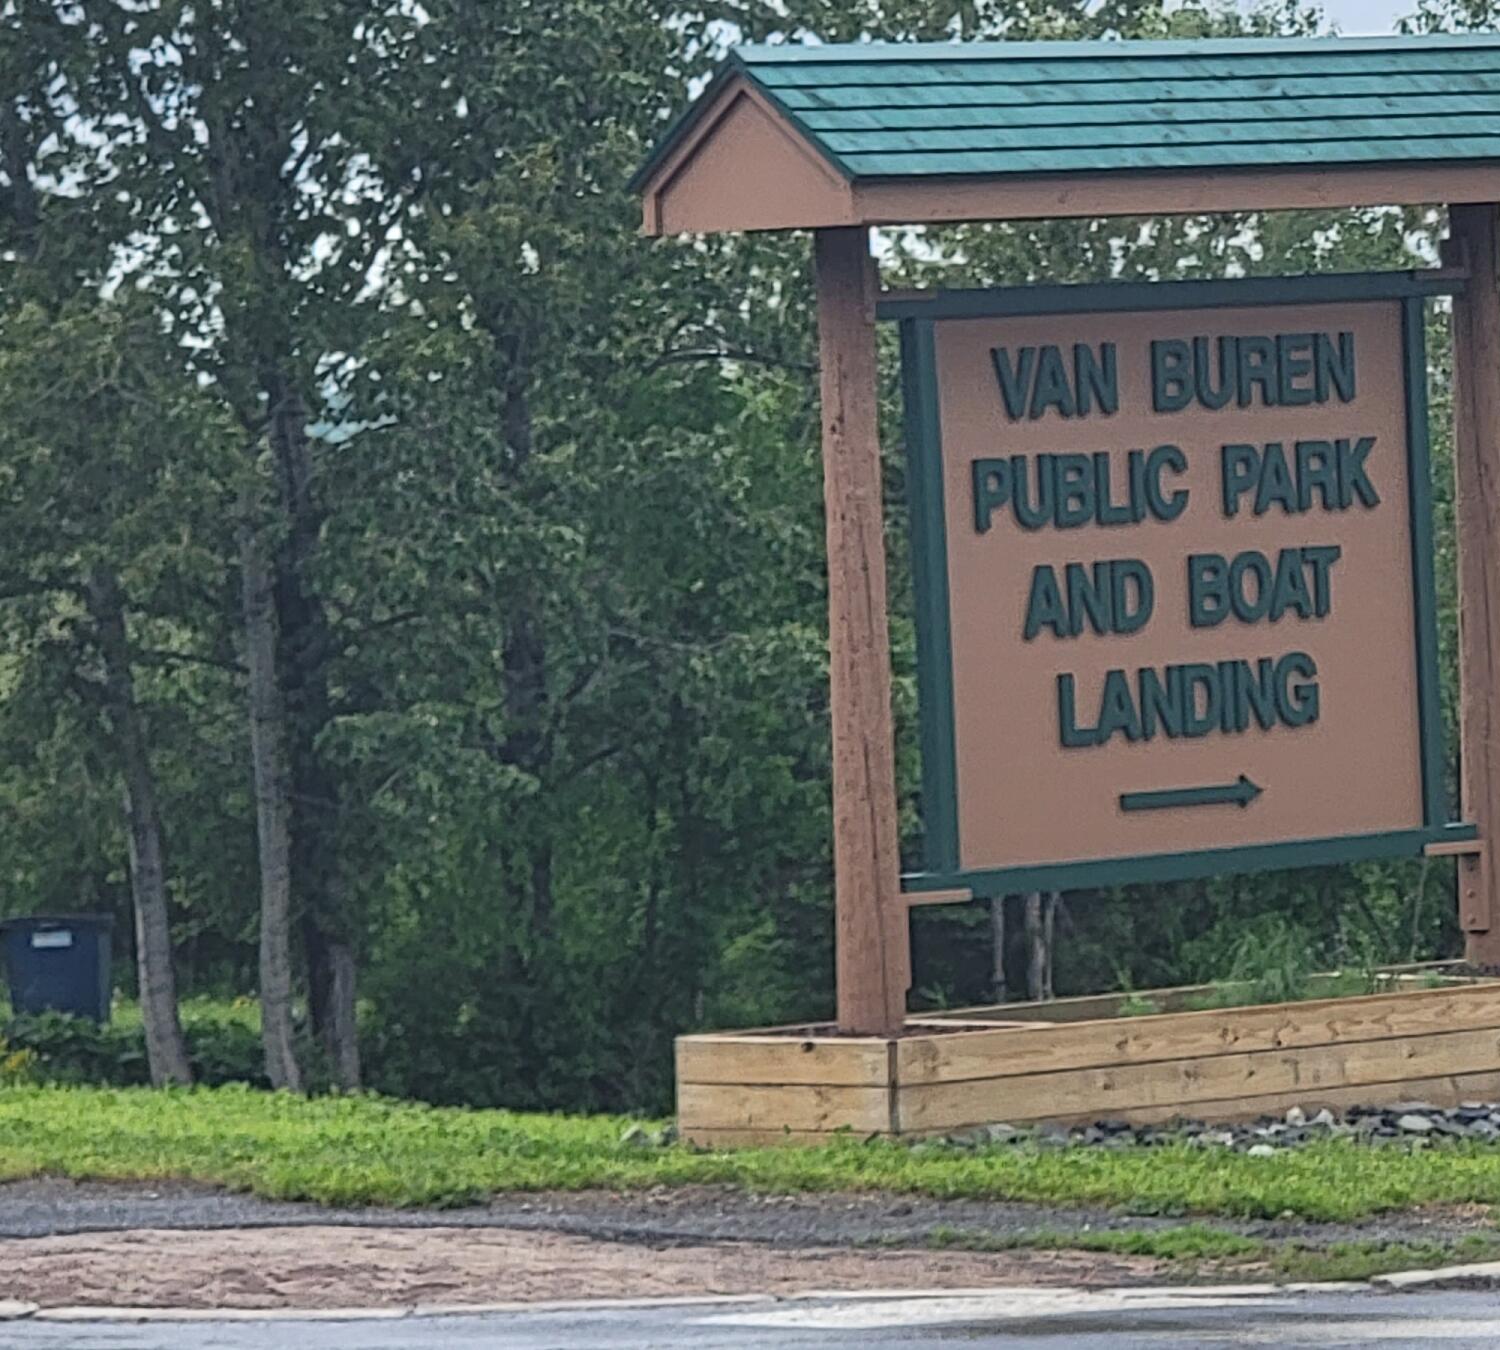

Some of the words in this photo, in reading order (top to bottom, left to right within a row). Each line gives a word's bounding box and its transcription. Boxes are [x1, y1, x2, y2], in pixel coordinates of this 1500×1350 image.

[990, 341, 1119, 422] VAN
[1151, 331, 1356, 414] BUREN
[971, 444, 1190, 534] PUBLIC
[1221, 436, 1381, 519] PARK
[1022, 558, 1155, 642] AND
[1188, 545, 1342, 629] BOAT
[1056, 651, 1321, 749] LANDING
